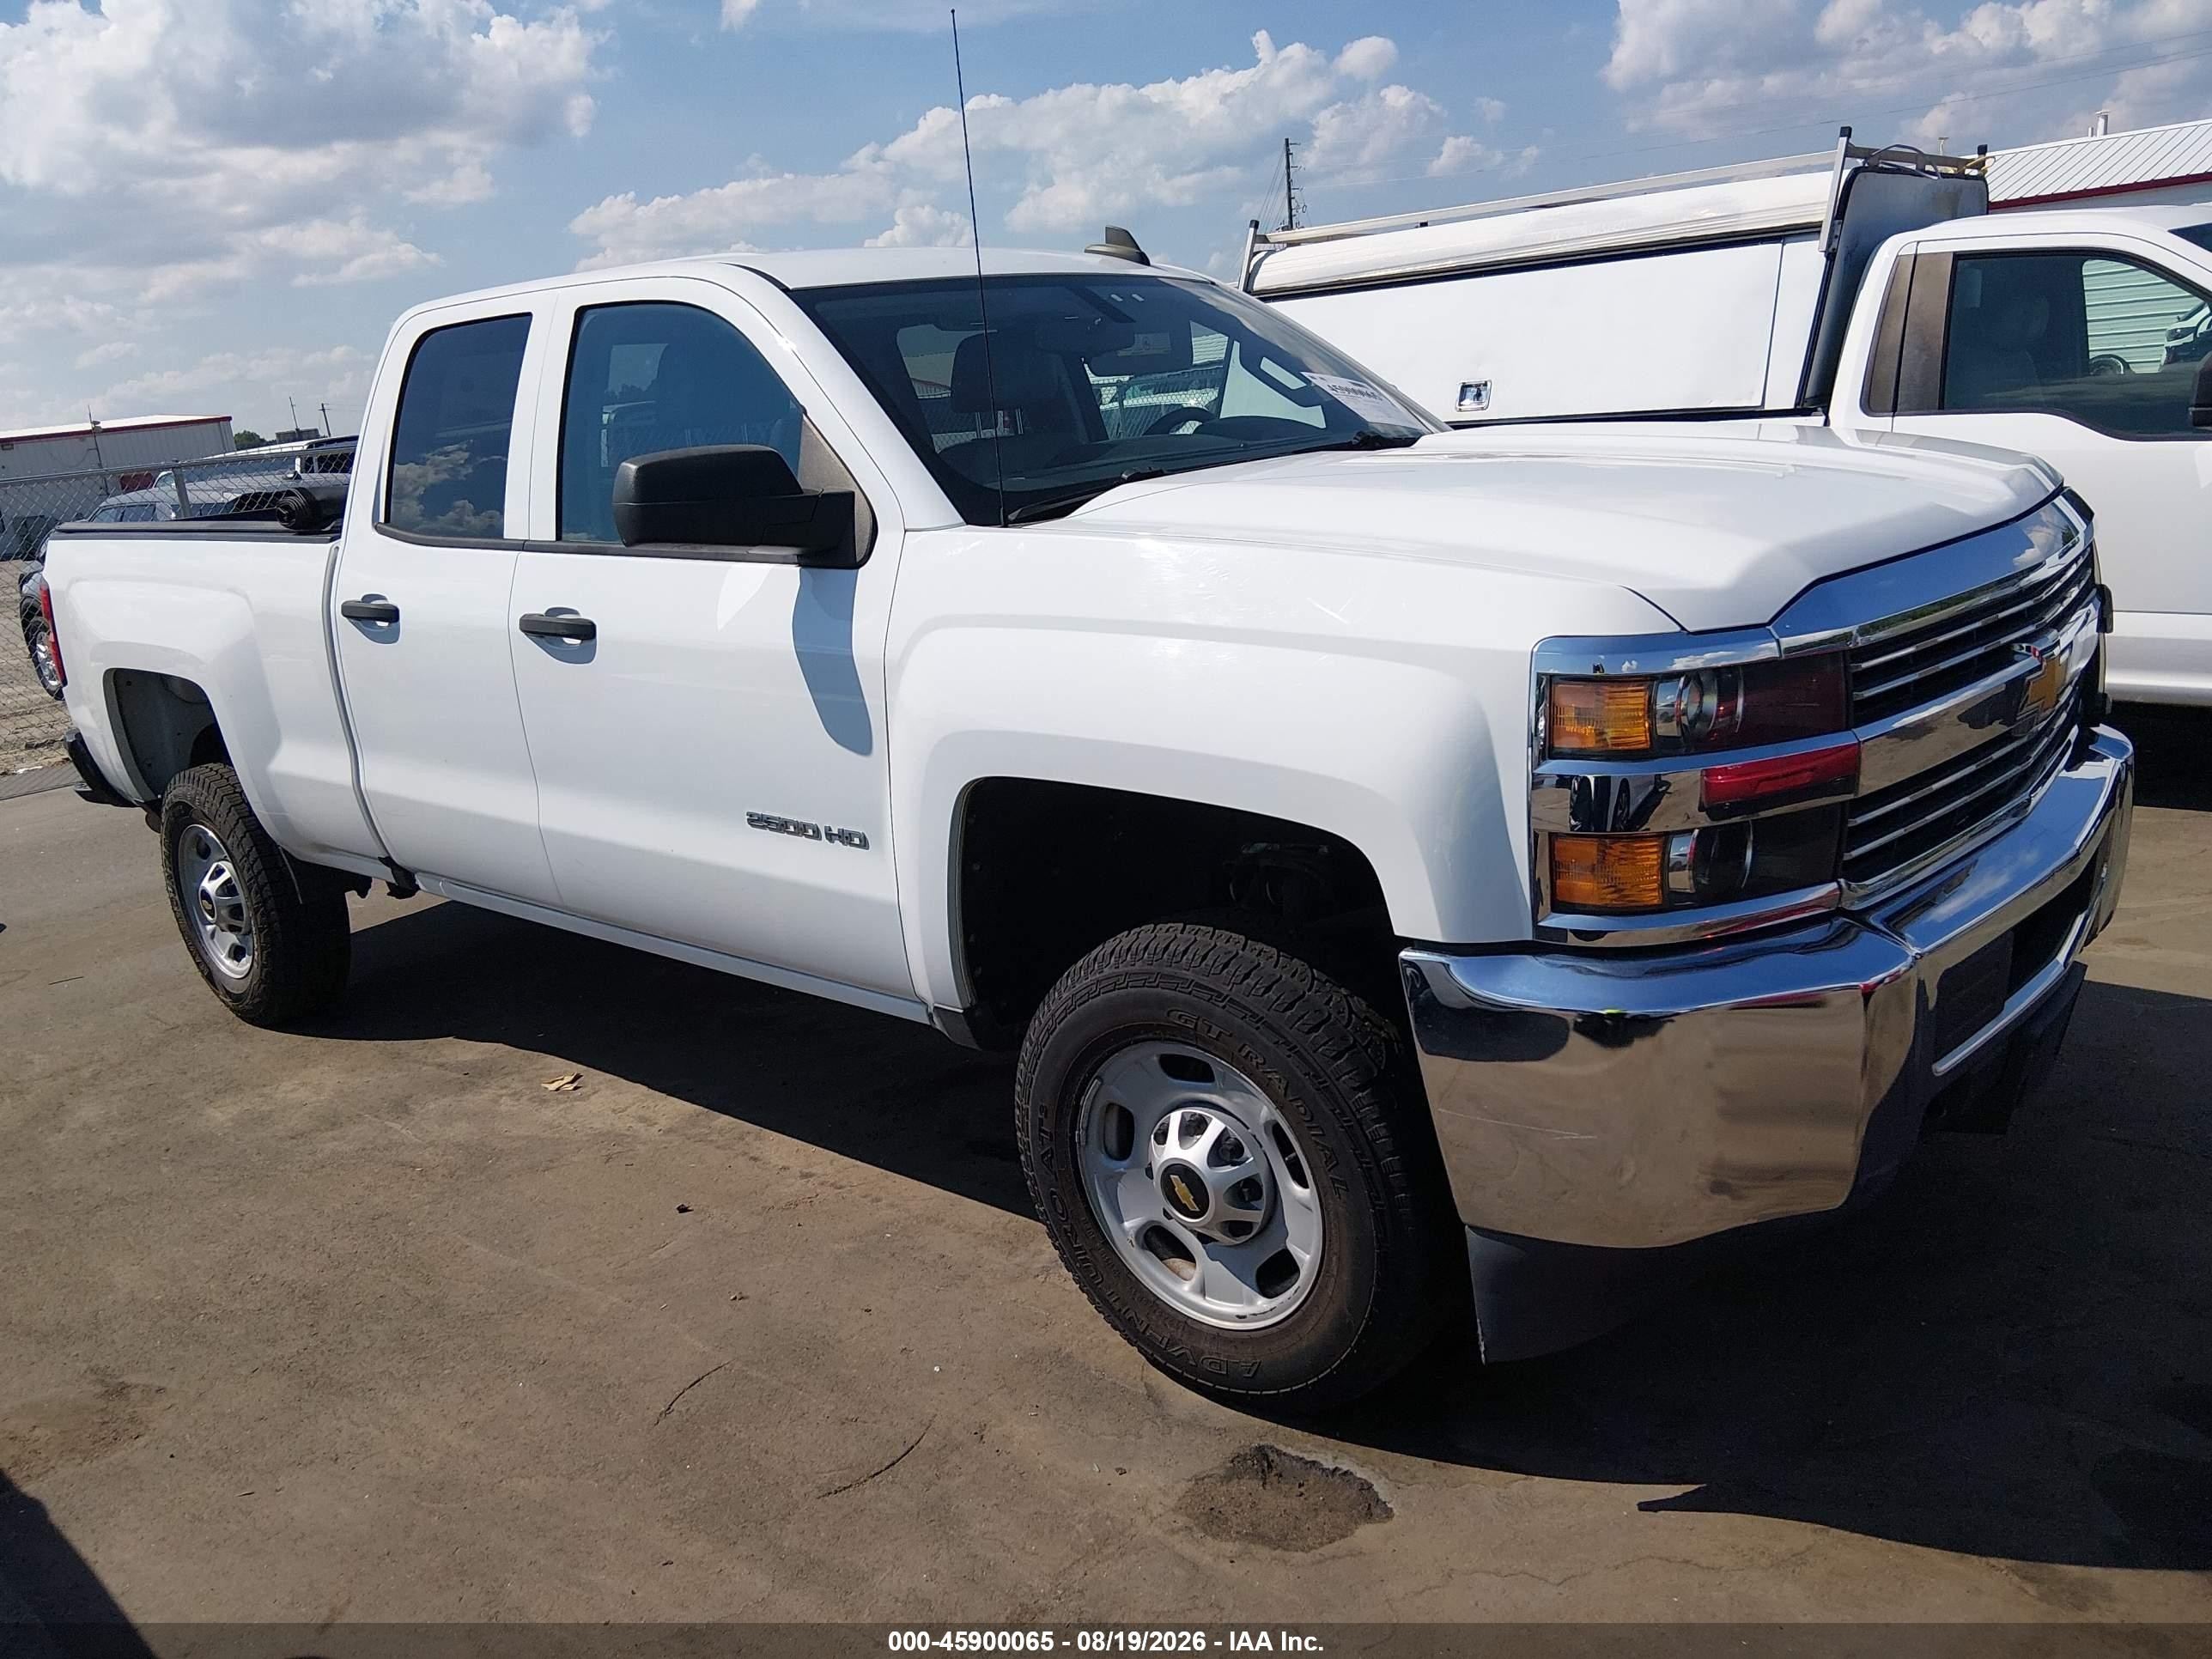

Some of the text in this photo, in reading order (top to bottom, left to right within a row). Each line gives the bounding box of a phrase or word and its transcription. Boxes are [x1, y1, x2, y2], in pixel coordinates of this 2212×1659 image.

[745, 811, 870, 850] 2500 HD
[1167, 1009, 1349, 1198] GT RADIAL
